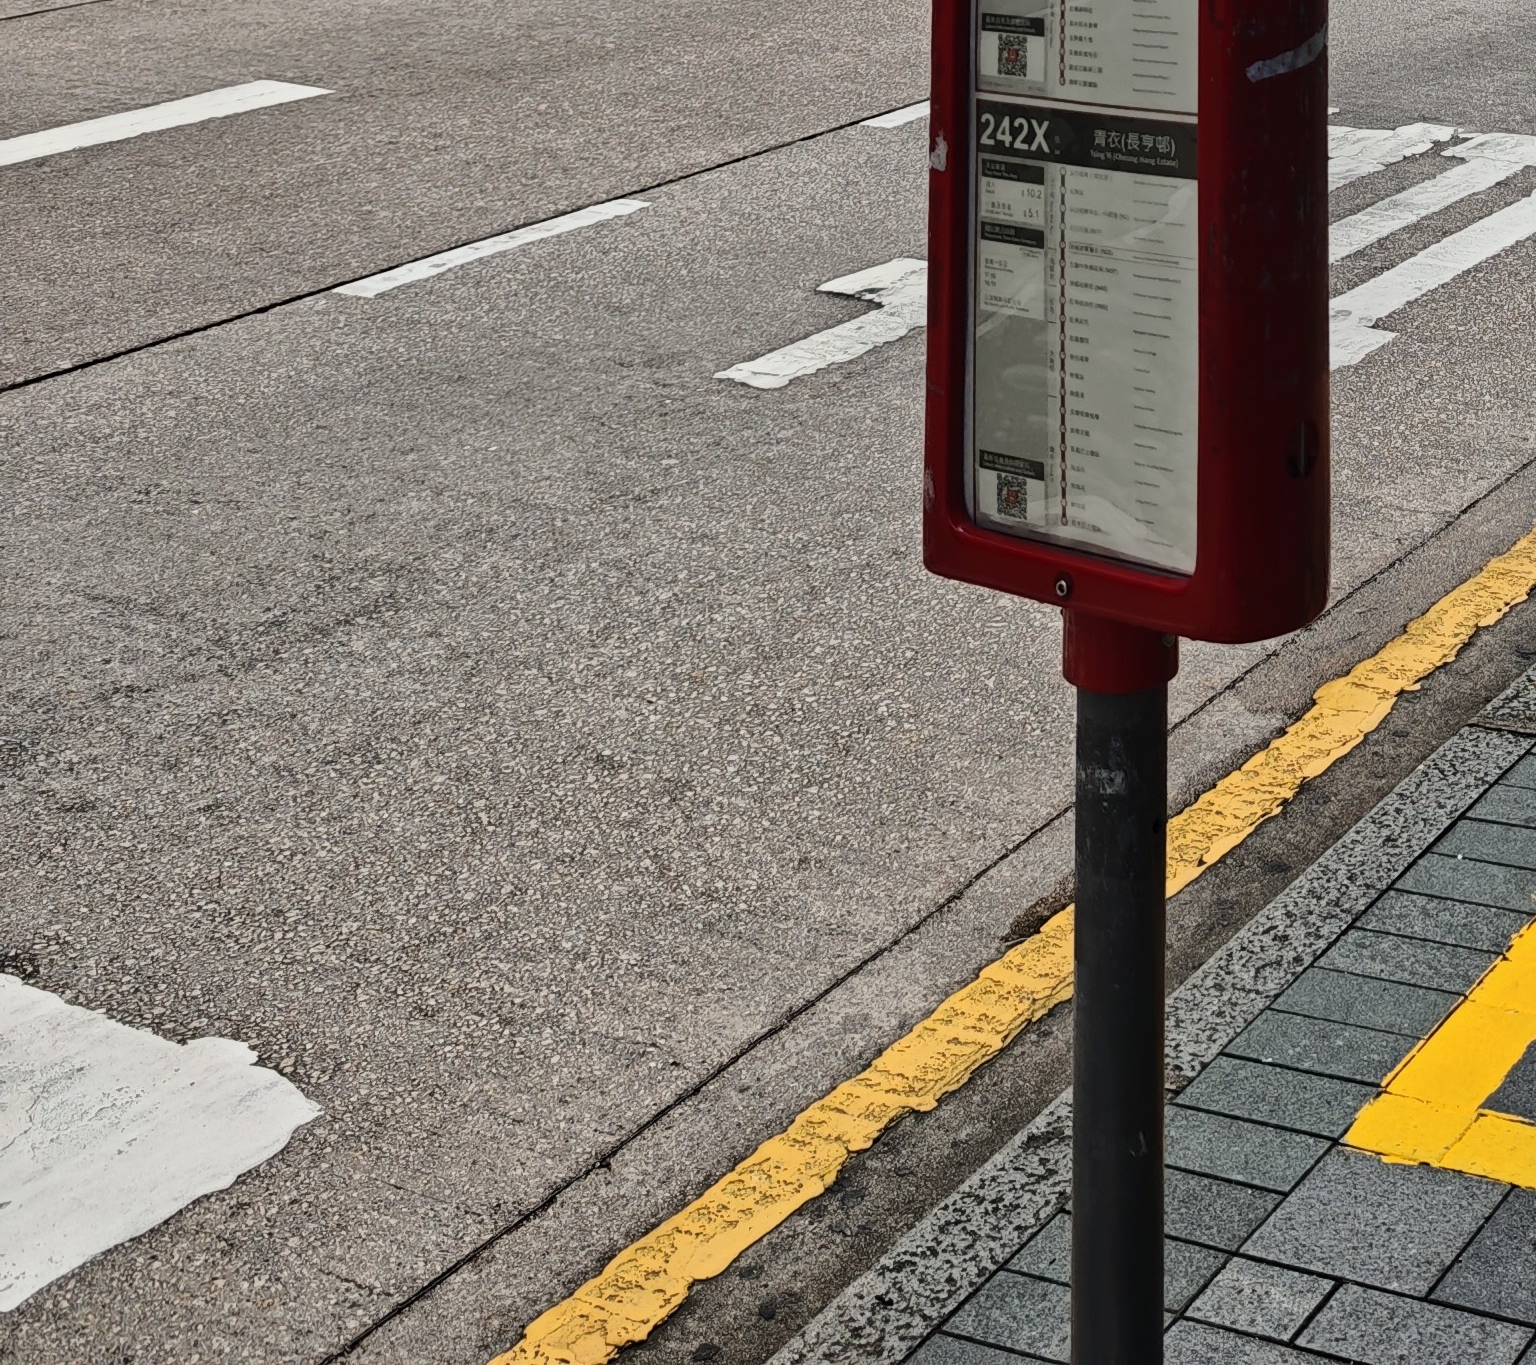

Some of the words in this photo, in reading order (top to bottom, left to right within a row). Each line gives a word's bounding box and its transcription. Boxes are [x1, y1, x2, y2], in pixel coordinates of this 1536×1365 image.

[980, 113, 1050, 153] 242X
[1094, 128, 1176, 157] 青衣(長亨邨)
